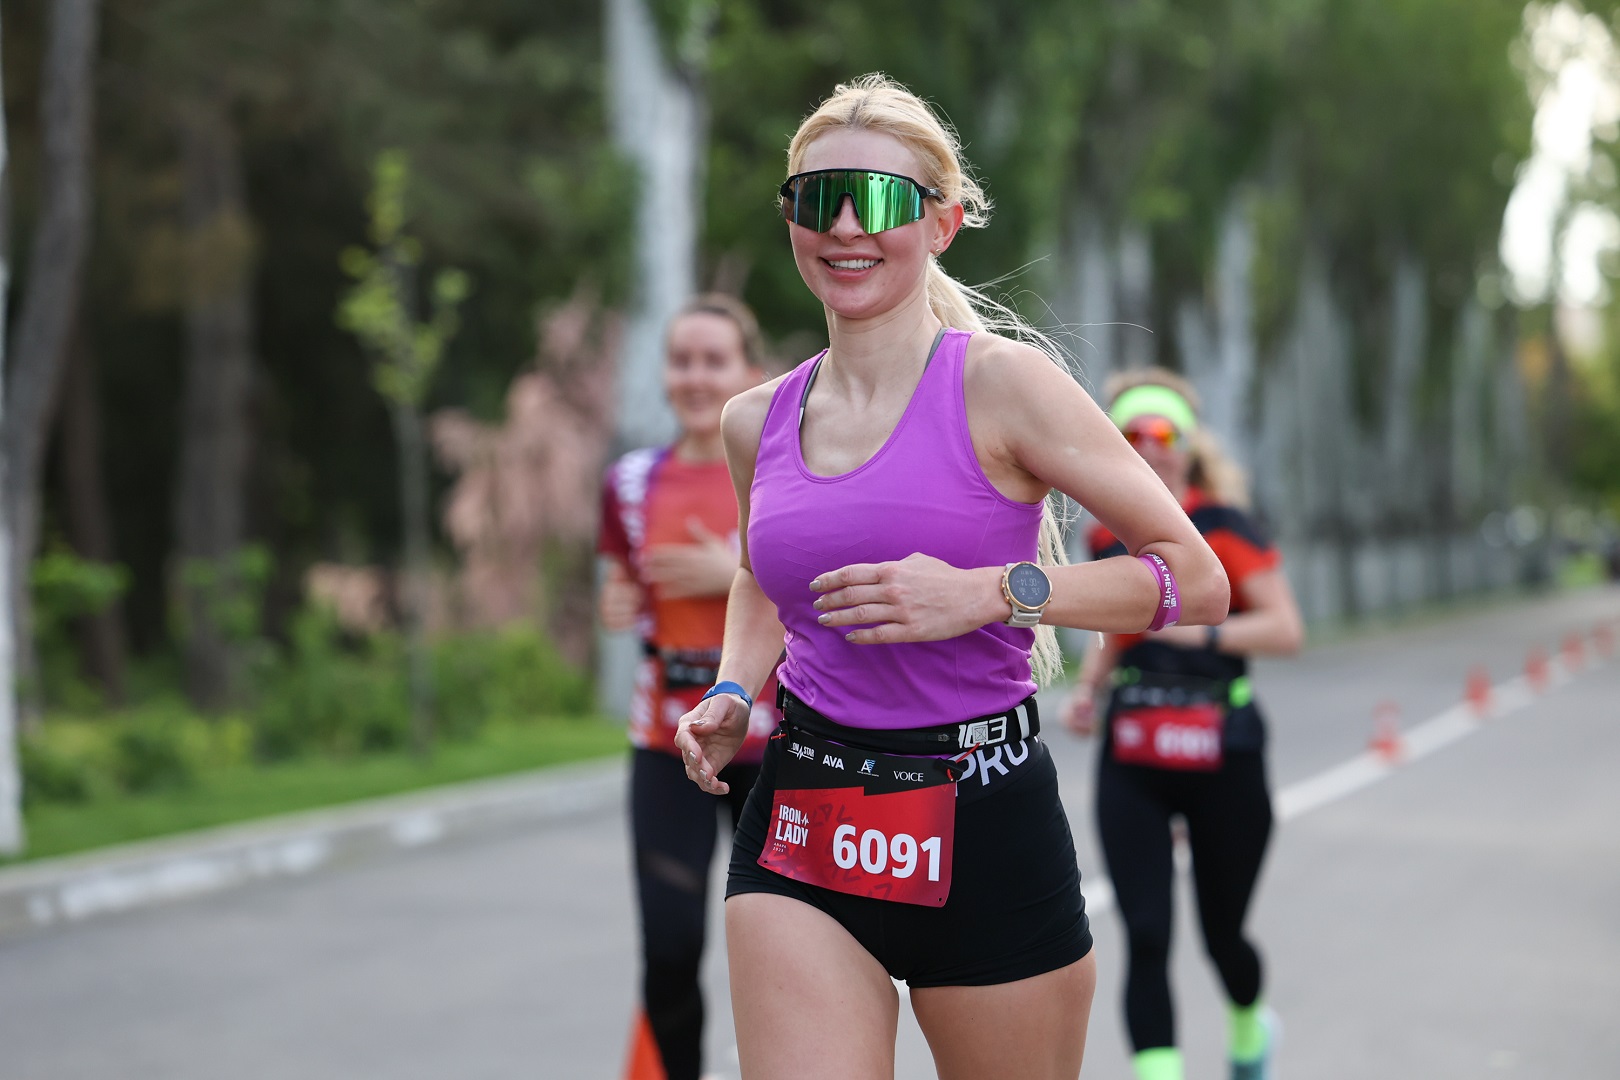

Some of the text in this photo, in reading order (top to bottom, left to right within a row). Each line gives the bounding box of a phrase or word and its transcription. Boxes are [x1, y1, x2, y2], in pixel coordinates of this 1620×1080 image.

[822, 754, 845, 771] AVA
[893, 770, 924, 783] VOICE
[779, 804, 802, 825] IRON
[775, 820, 809, 848] LADY
[832, 823, 942, 882] 6091
